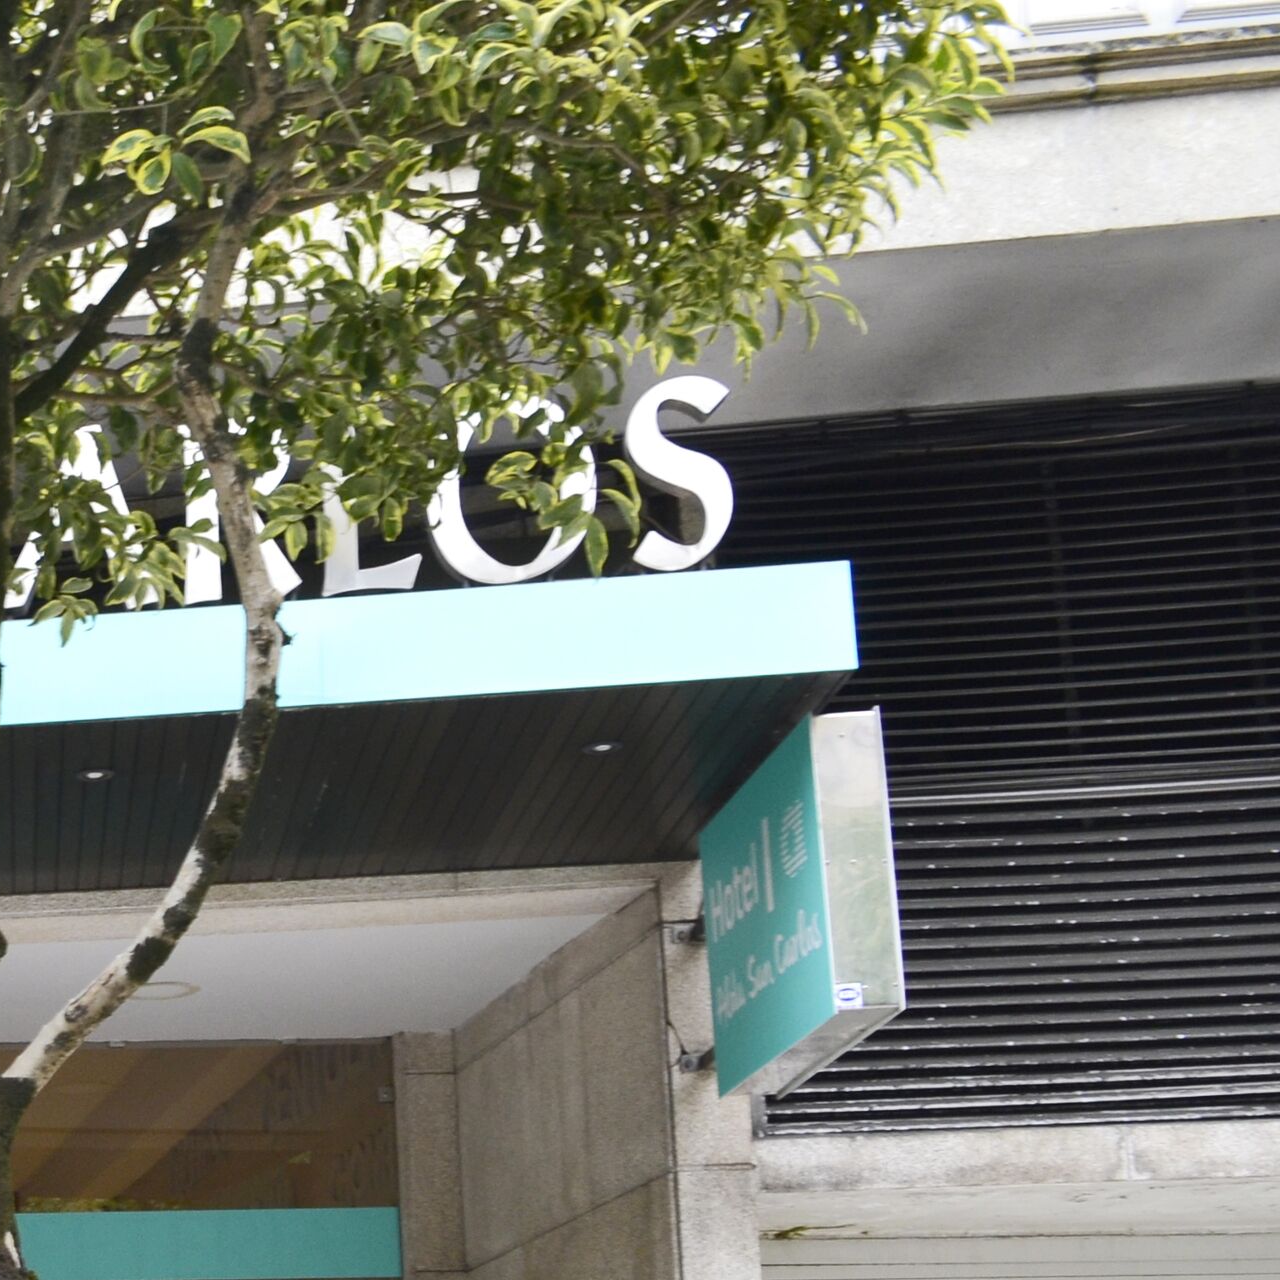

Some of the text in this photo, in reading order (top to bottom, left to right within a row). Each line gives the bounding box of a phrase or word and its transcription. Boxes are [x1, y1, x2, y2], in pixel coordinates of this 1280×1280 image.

[709, 843, 759, 943] Hotel
[747, 955, 776, 998] San
[773, 909, 823, 974] Carlos
